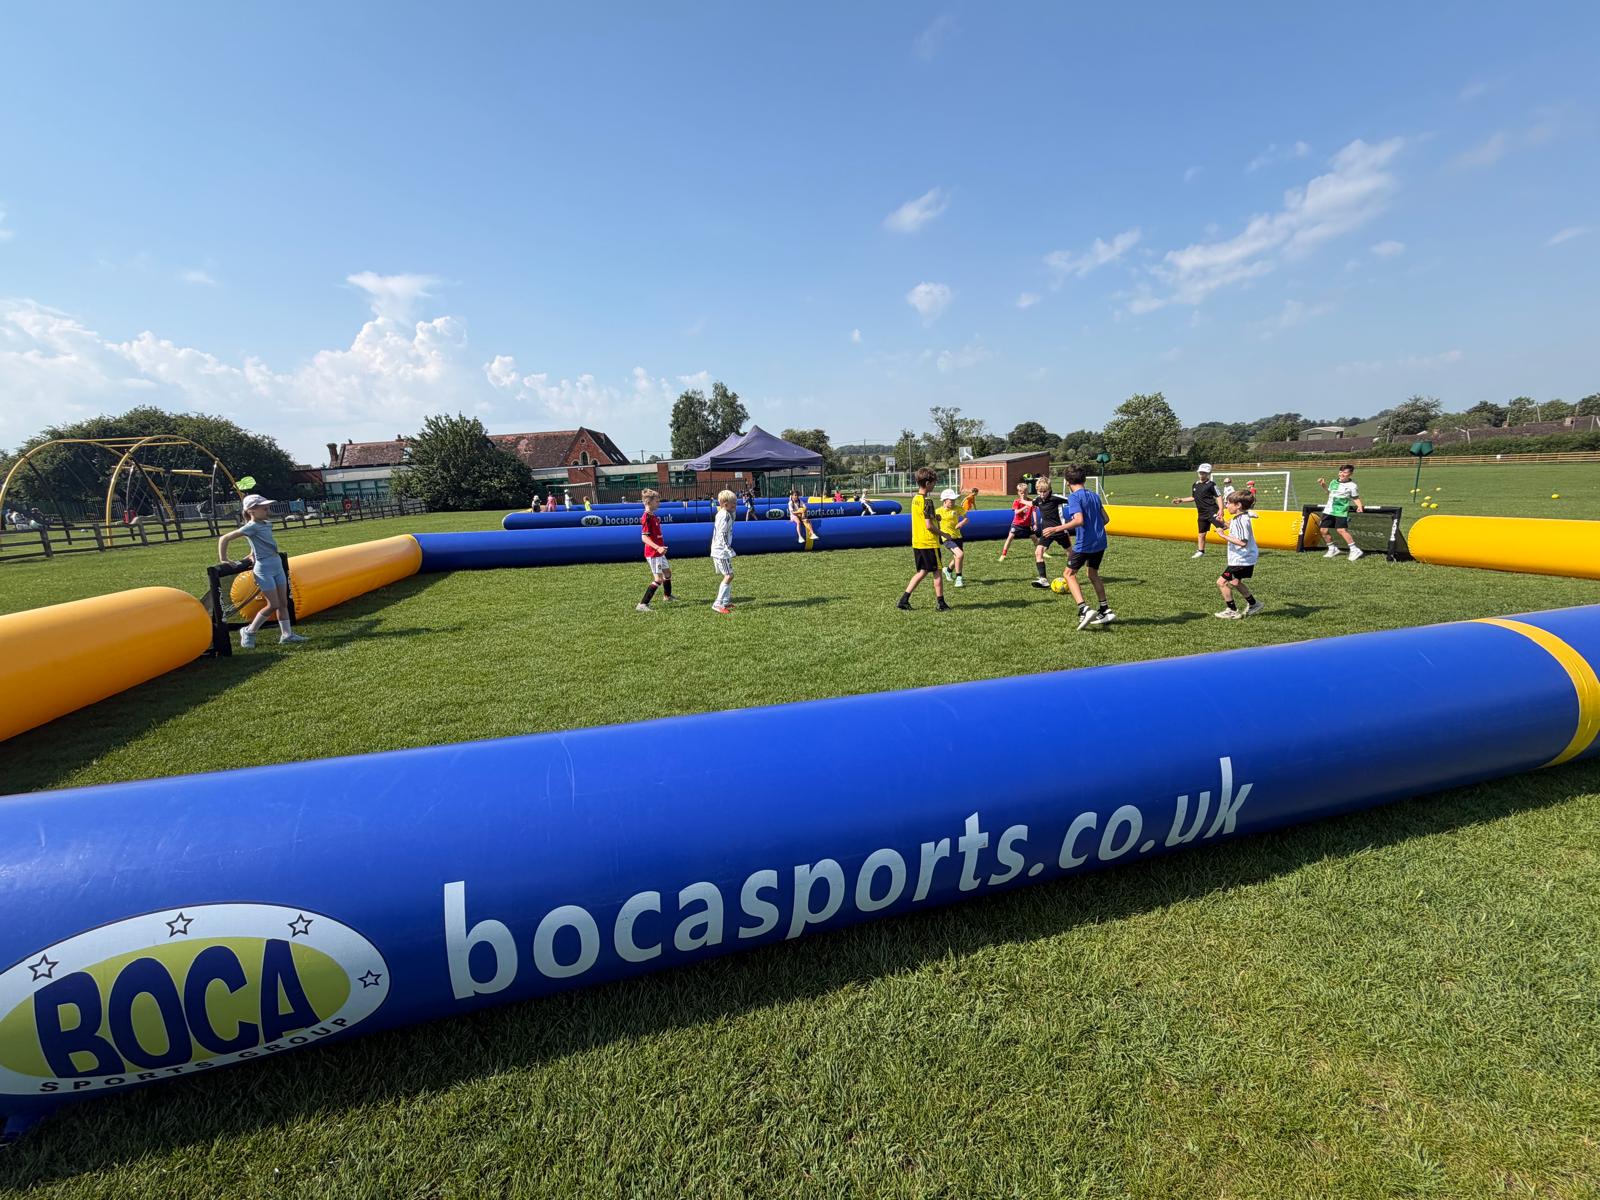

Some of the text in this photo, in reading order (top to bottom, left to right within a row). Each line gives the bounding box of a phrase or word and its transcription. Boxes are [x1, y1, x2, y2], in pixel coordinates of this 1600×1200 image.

[443, 756, 1254, 1000] bocasports.co.uk
[34, 938, 322, 1078] BOCA
[39, 1016, 349, 1093] SPORTS GROUP
